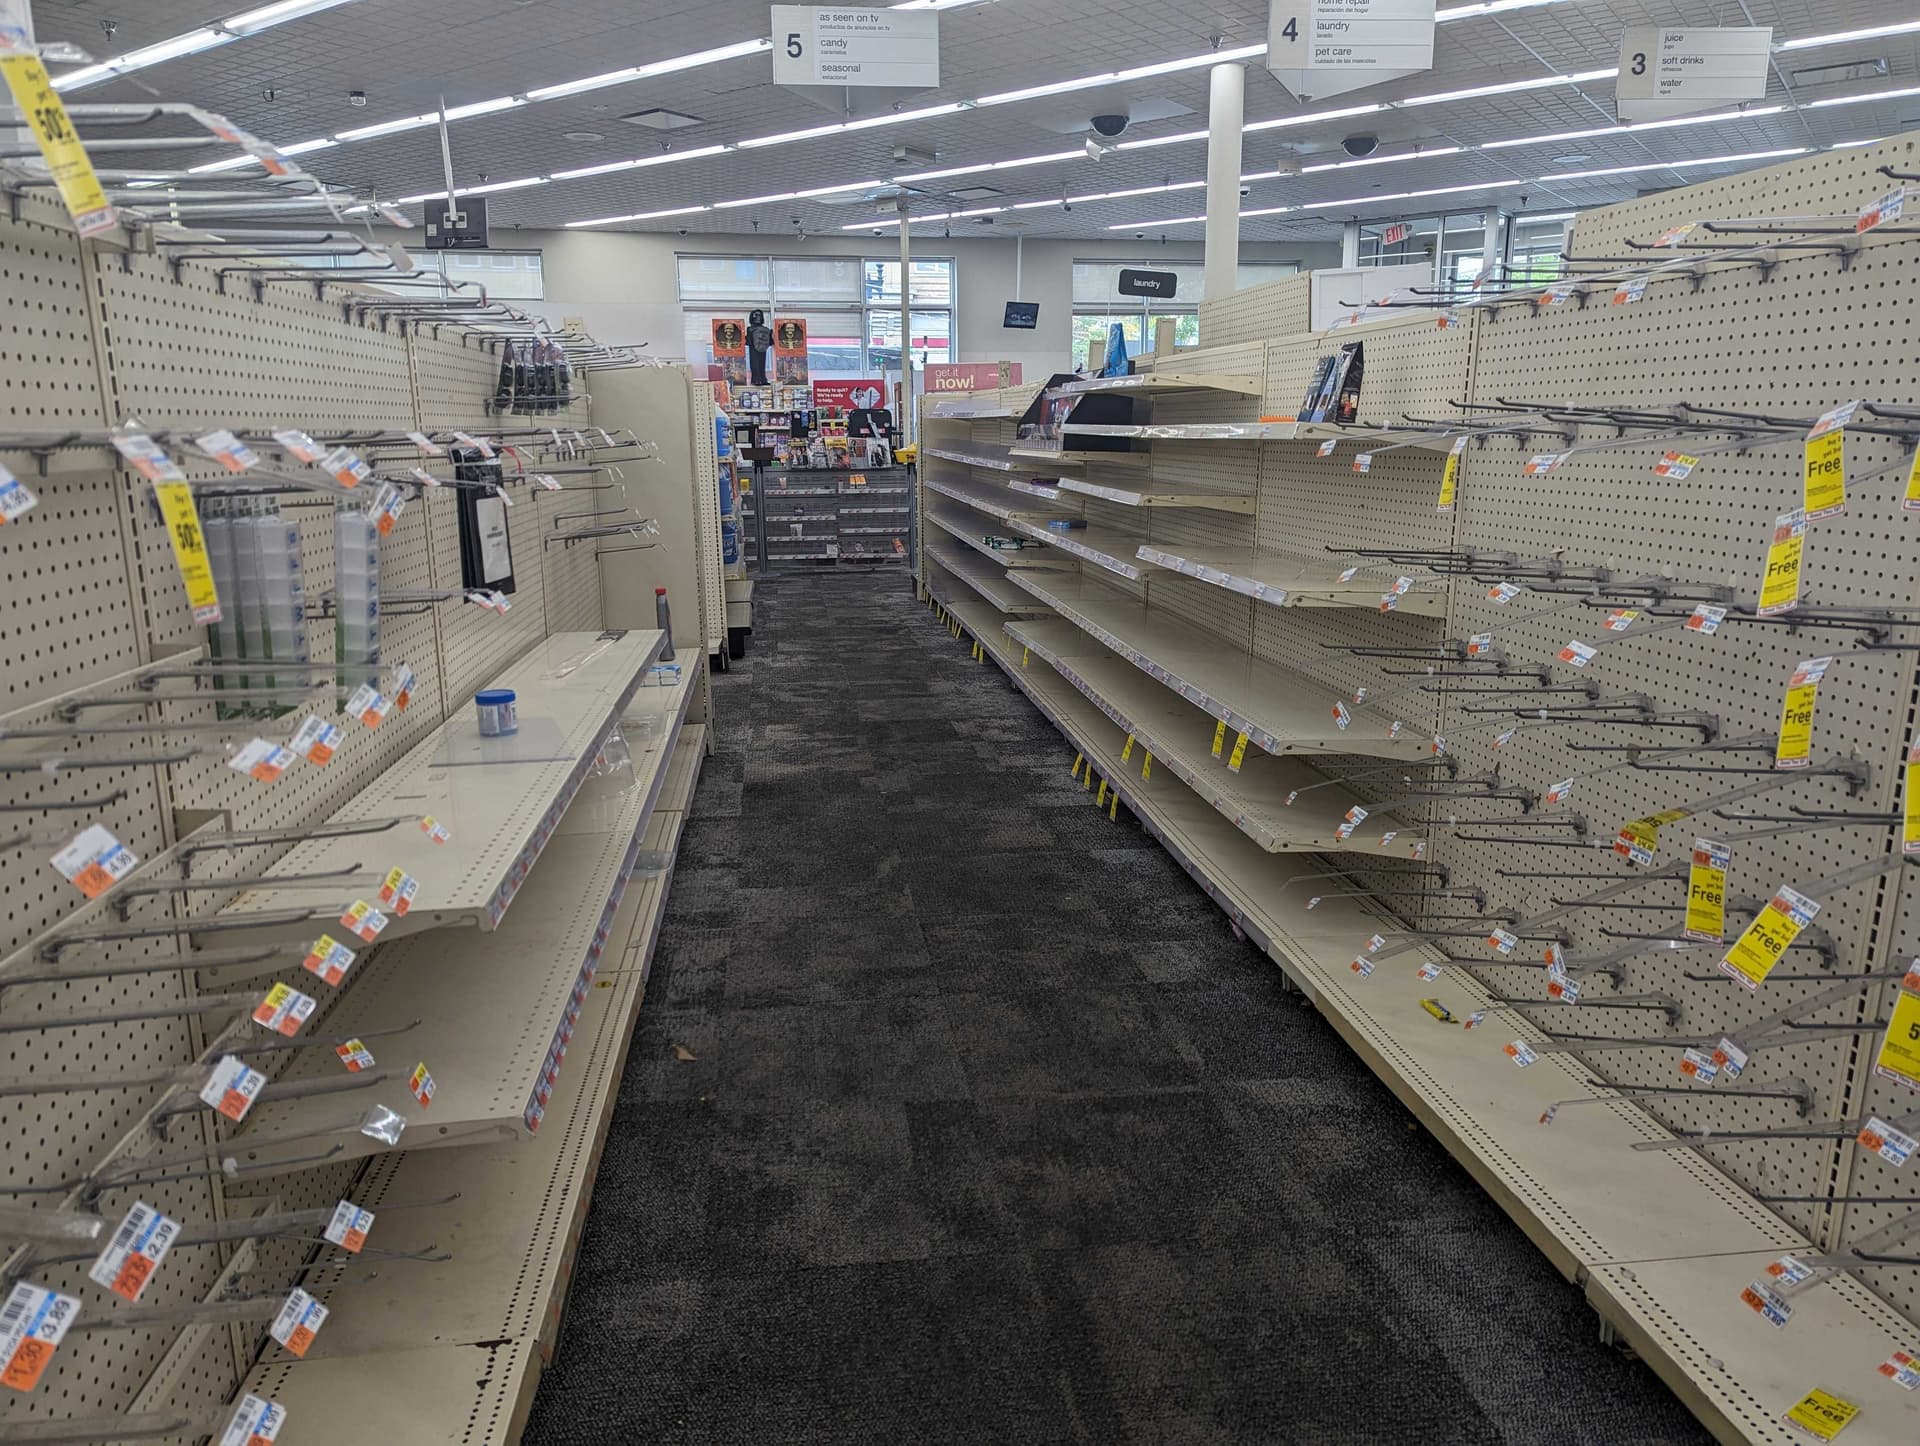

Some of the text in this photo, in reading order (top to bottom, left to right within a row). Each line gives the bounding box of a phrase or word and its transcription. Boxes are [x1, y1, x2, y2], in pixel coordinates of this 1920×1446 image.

[820, 13, 879, 22] as seen on tv
[1282, 17, 1299, 42] 4
[1317, 21, 1350, 32] laundry
[787, 33, 802, 58] 5
[820, 38, 848, 49] candy
[1664, 33, 1684, 43] juice
[1315, 47, 1330, 57] pet
[822, 63, 861, 73] seasonal
[1631, 53, 1646, 75] 3
[1662, 56, 1704, 65] soft drinks
[1660, 79, 1682, 87] water
[1385, 224, 1405, 243] EXIT
[1133, 278, 1161, 290] laundry
[935, 367, 960, 378] get it
[935, 374, 975, 389] now!
[1808, 457, 1841, 478] Free
[1768, 558, 1799, 577] Free
[1784, 708, 1812, 725] Free
[1691, 884, 1722, 905] Free
[1749, 922, 1782, 955] Free
[1804, 1397, 1846, 1423] Free
